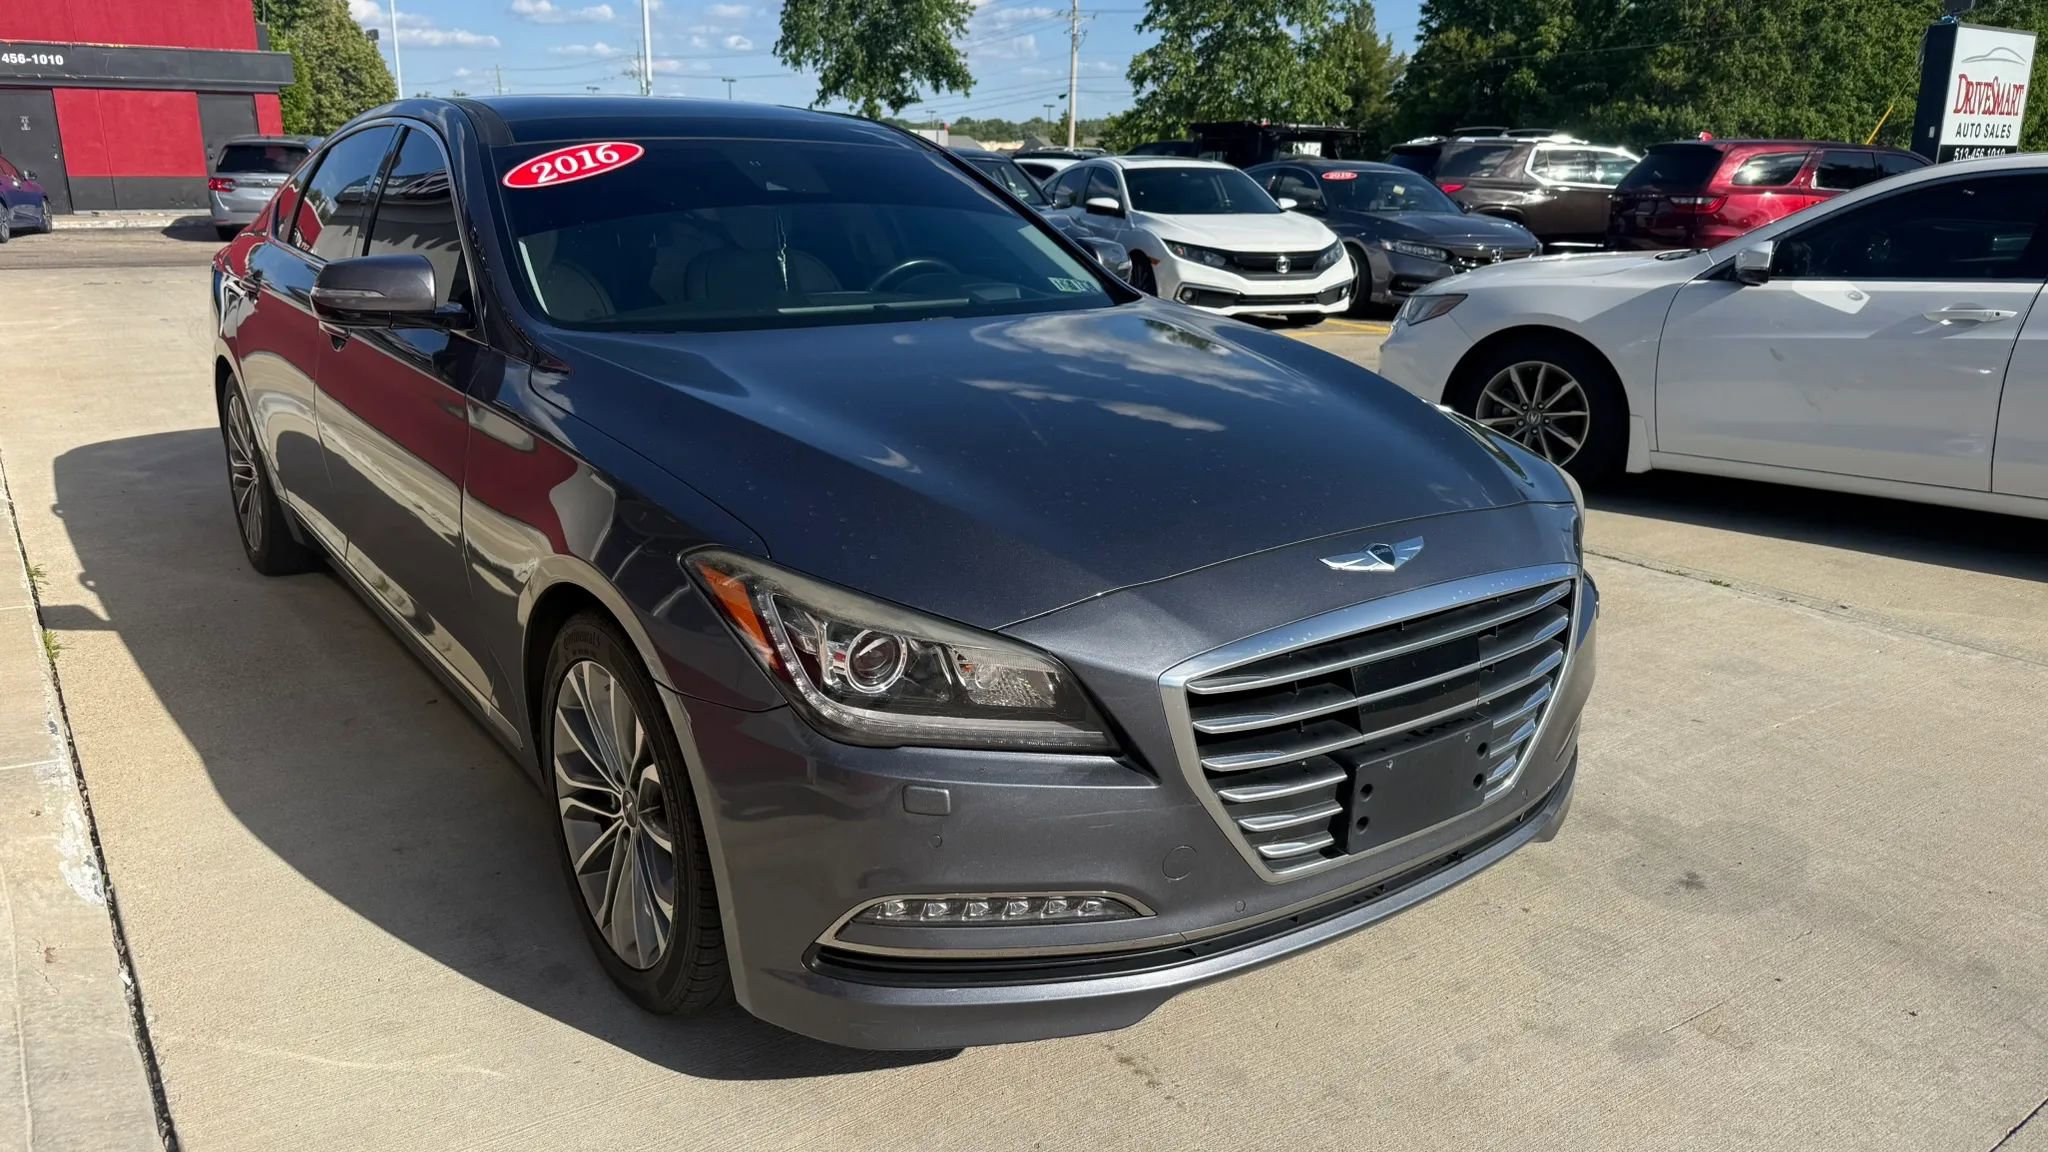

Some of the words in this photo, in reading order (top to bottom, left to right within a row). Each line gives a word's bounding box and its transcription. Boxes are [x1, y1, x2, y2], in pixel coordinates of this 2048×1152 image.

[1, 53, 64, 66] 456-1010
[1955, 122, 1982, 139] AUTO
[1984, 123, 2011, 139] SALES
[531, 144, 620, 184] 2016
